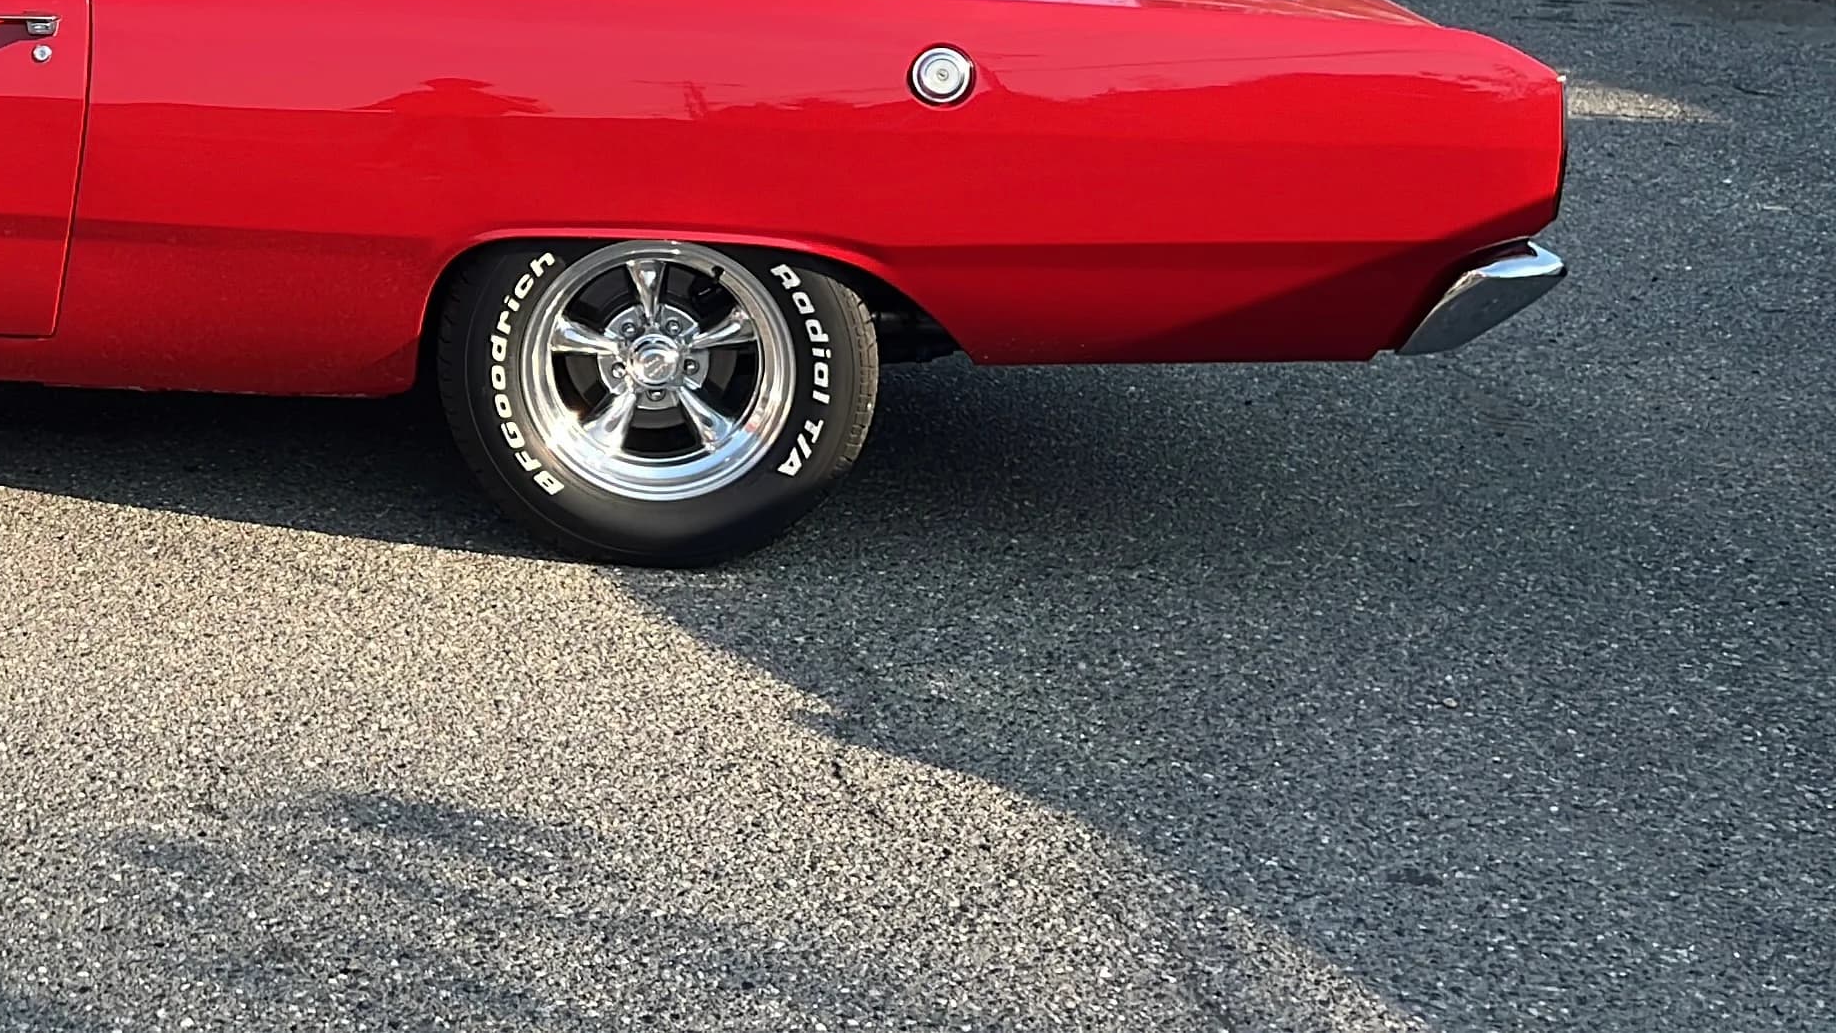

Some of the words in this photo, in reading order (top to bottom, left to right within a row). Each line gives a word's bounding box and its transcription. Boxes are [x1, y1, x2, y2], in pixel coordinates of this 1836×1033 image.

[489, 252, 565, 495] BFGoodrich
[769, 262, 834, 407] Radial
[776, 418, 825, 480] T/A
